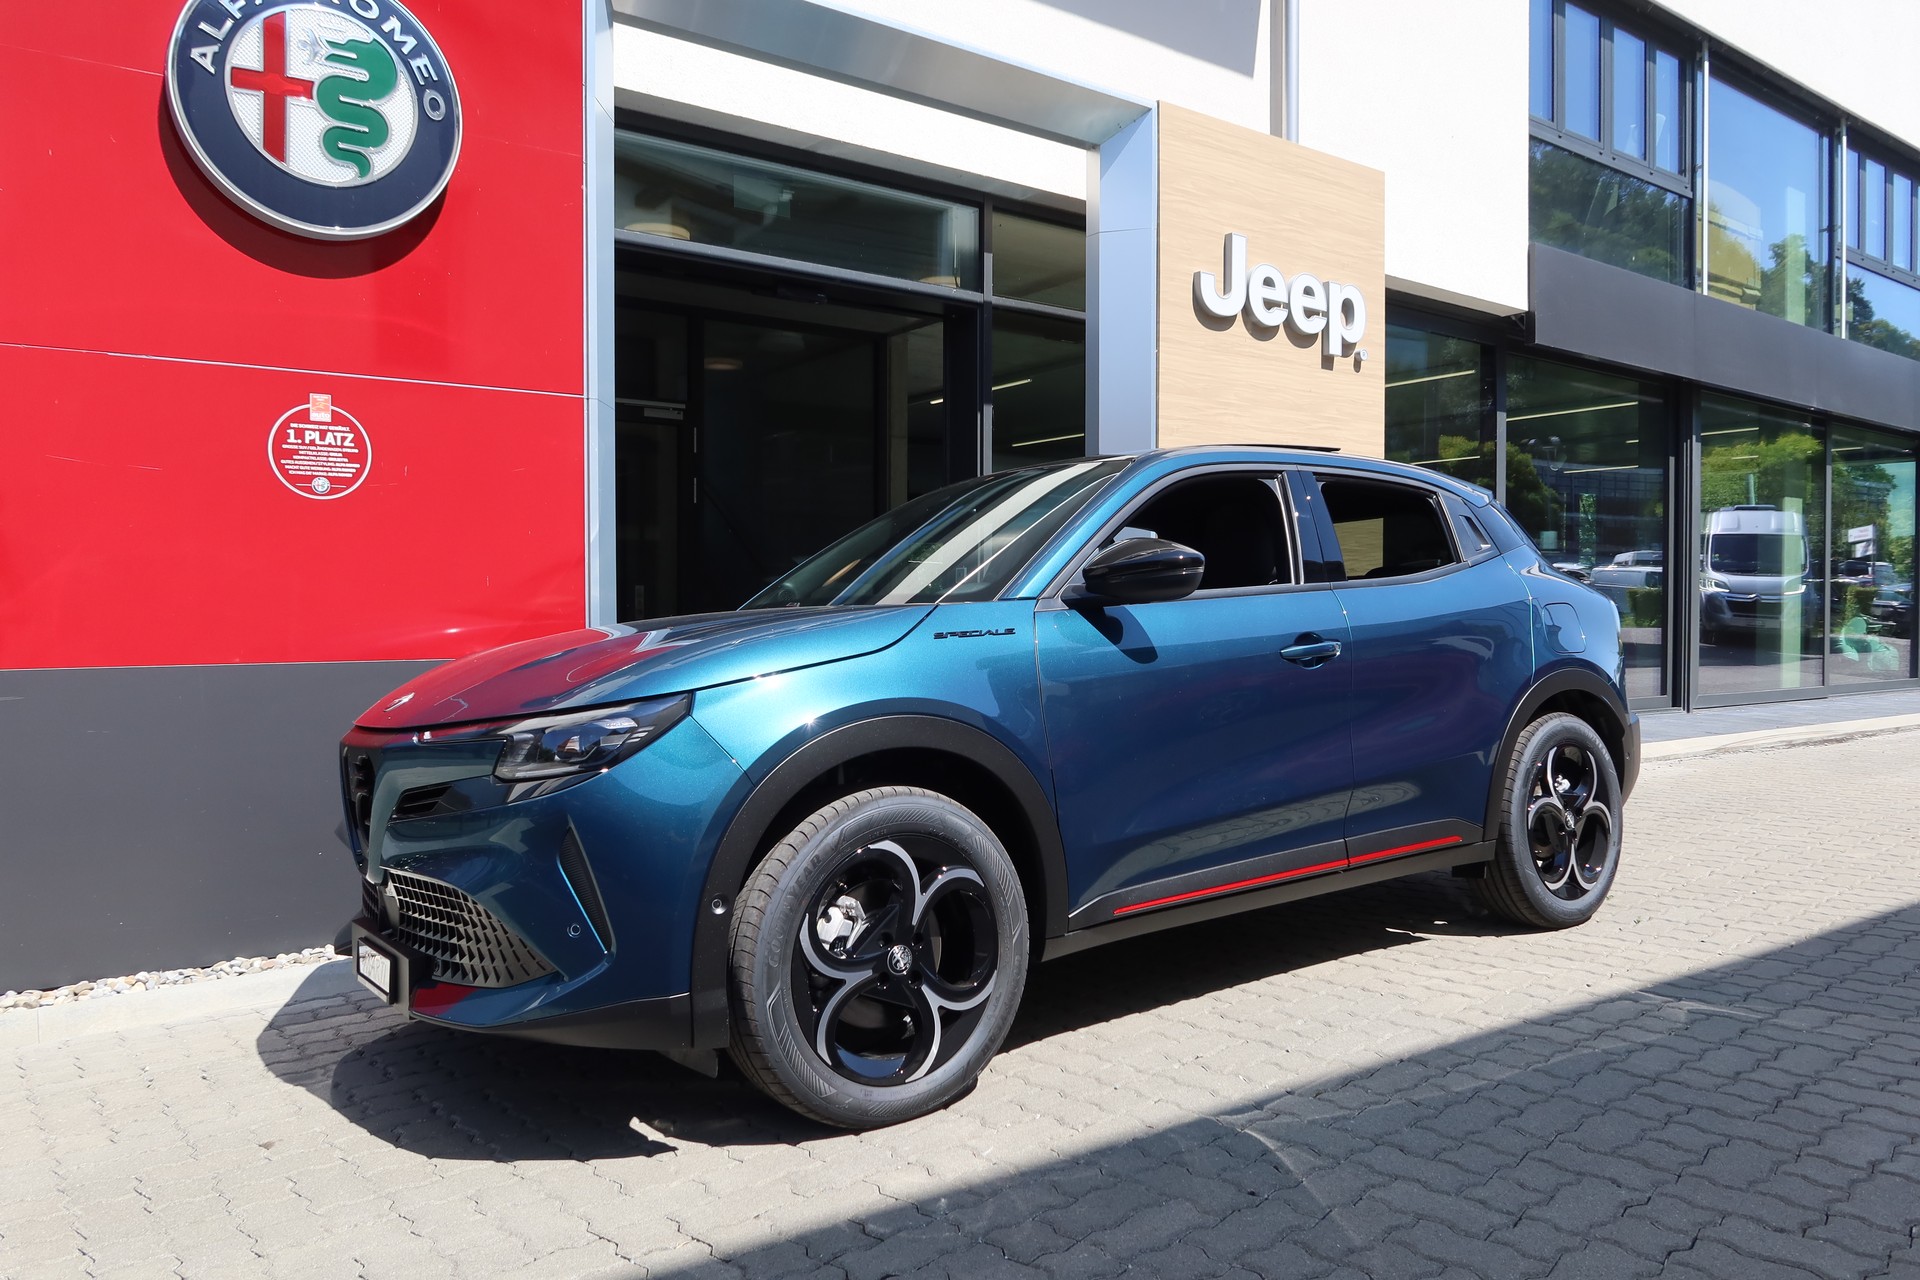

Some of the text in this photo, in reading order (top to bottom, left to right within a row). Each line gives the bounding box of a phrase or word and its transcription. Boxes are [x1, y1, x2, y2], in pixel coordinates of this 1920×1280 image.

[189, 0, 446, 121] ALF OMEO
[1192, 232, 1367, 357] Jeep
[286, 429, 355, 447] 1. PLATZ
[933, 627, 1016, 641] SPECIALE
